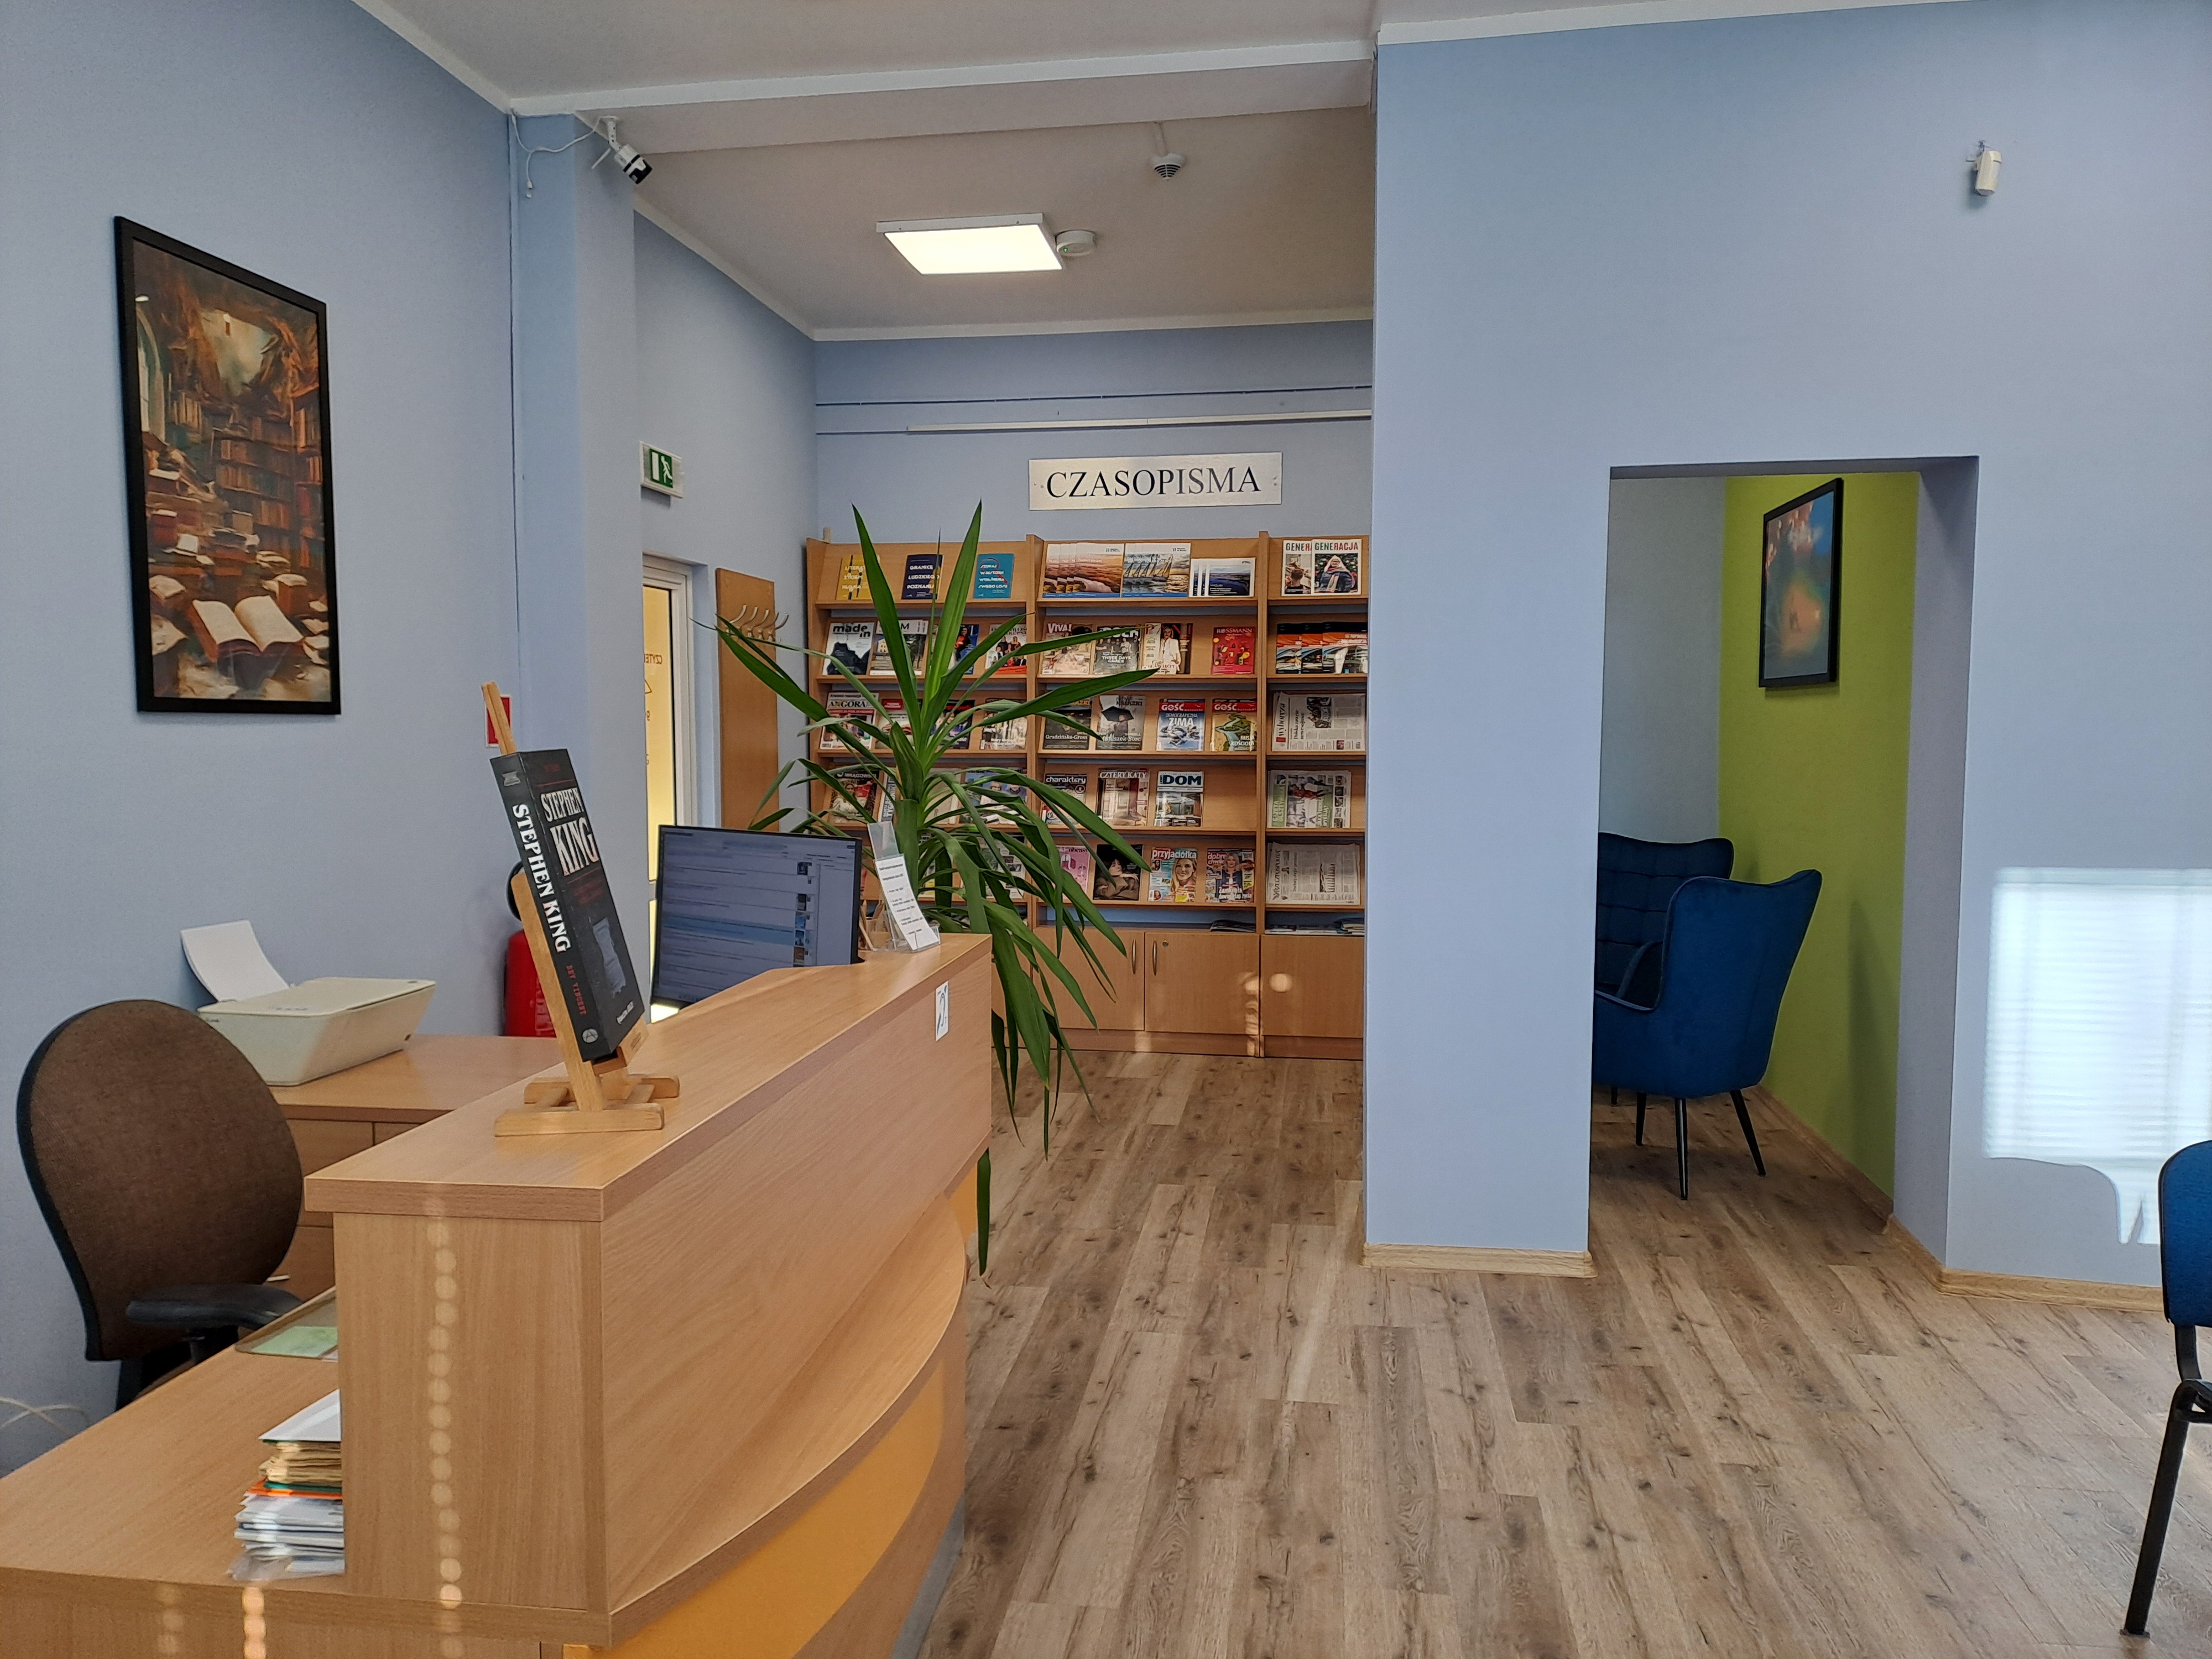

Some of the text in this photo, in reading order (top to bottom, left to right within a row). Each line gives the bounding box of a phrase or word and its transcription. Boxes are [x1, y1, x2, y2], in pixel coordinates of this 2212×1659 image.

[1052, 466, 1266, 498] CZASOPISMA
[1286, 542, 1312, 551] GENER
[1047, 623, 1072, 634] VIVA!
[1161, 703, 1185, 711] GOŚĆ
[1214, 703, 1238, 711] GOŚĆ
[1168, 717, 1194, 726] ZIMA
[1046, 776, 1087, 784] charaktery
[1162, 775, 1201, 785] DOM
[540, 787, 585, 823] STEPHEN
[549, 816, 600, 877] KING
[1152, 849, 1197, 859] przyjaciółka
[512, 804, 555, 898] STEPHEN
[542, 897, 573, 954] KING
